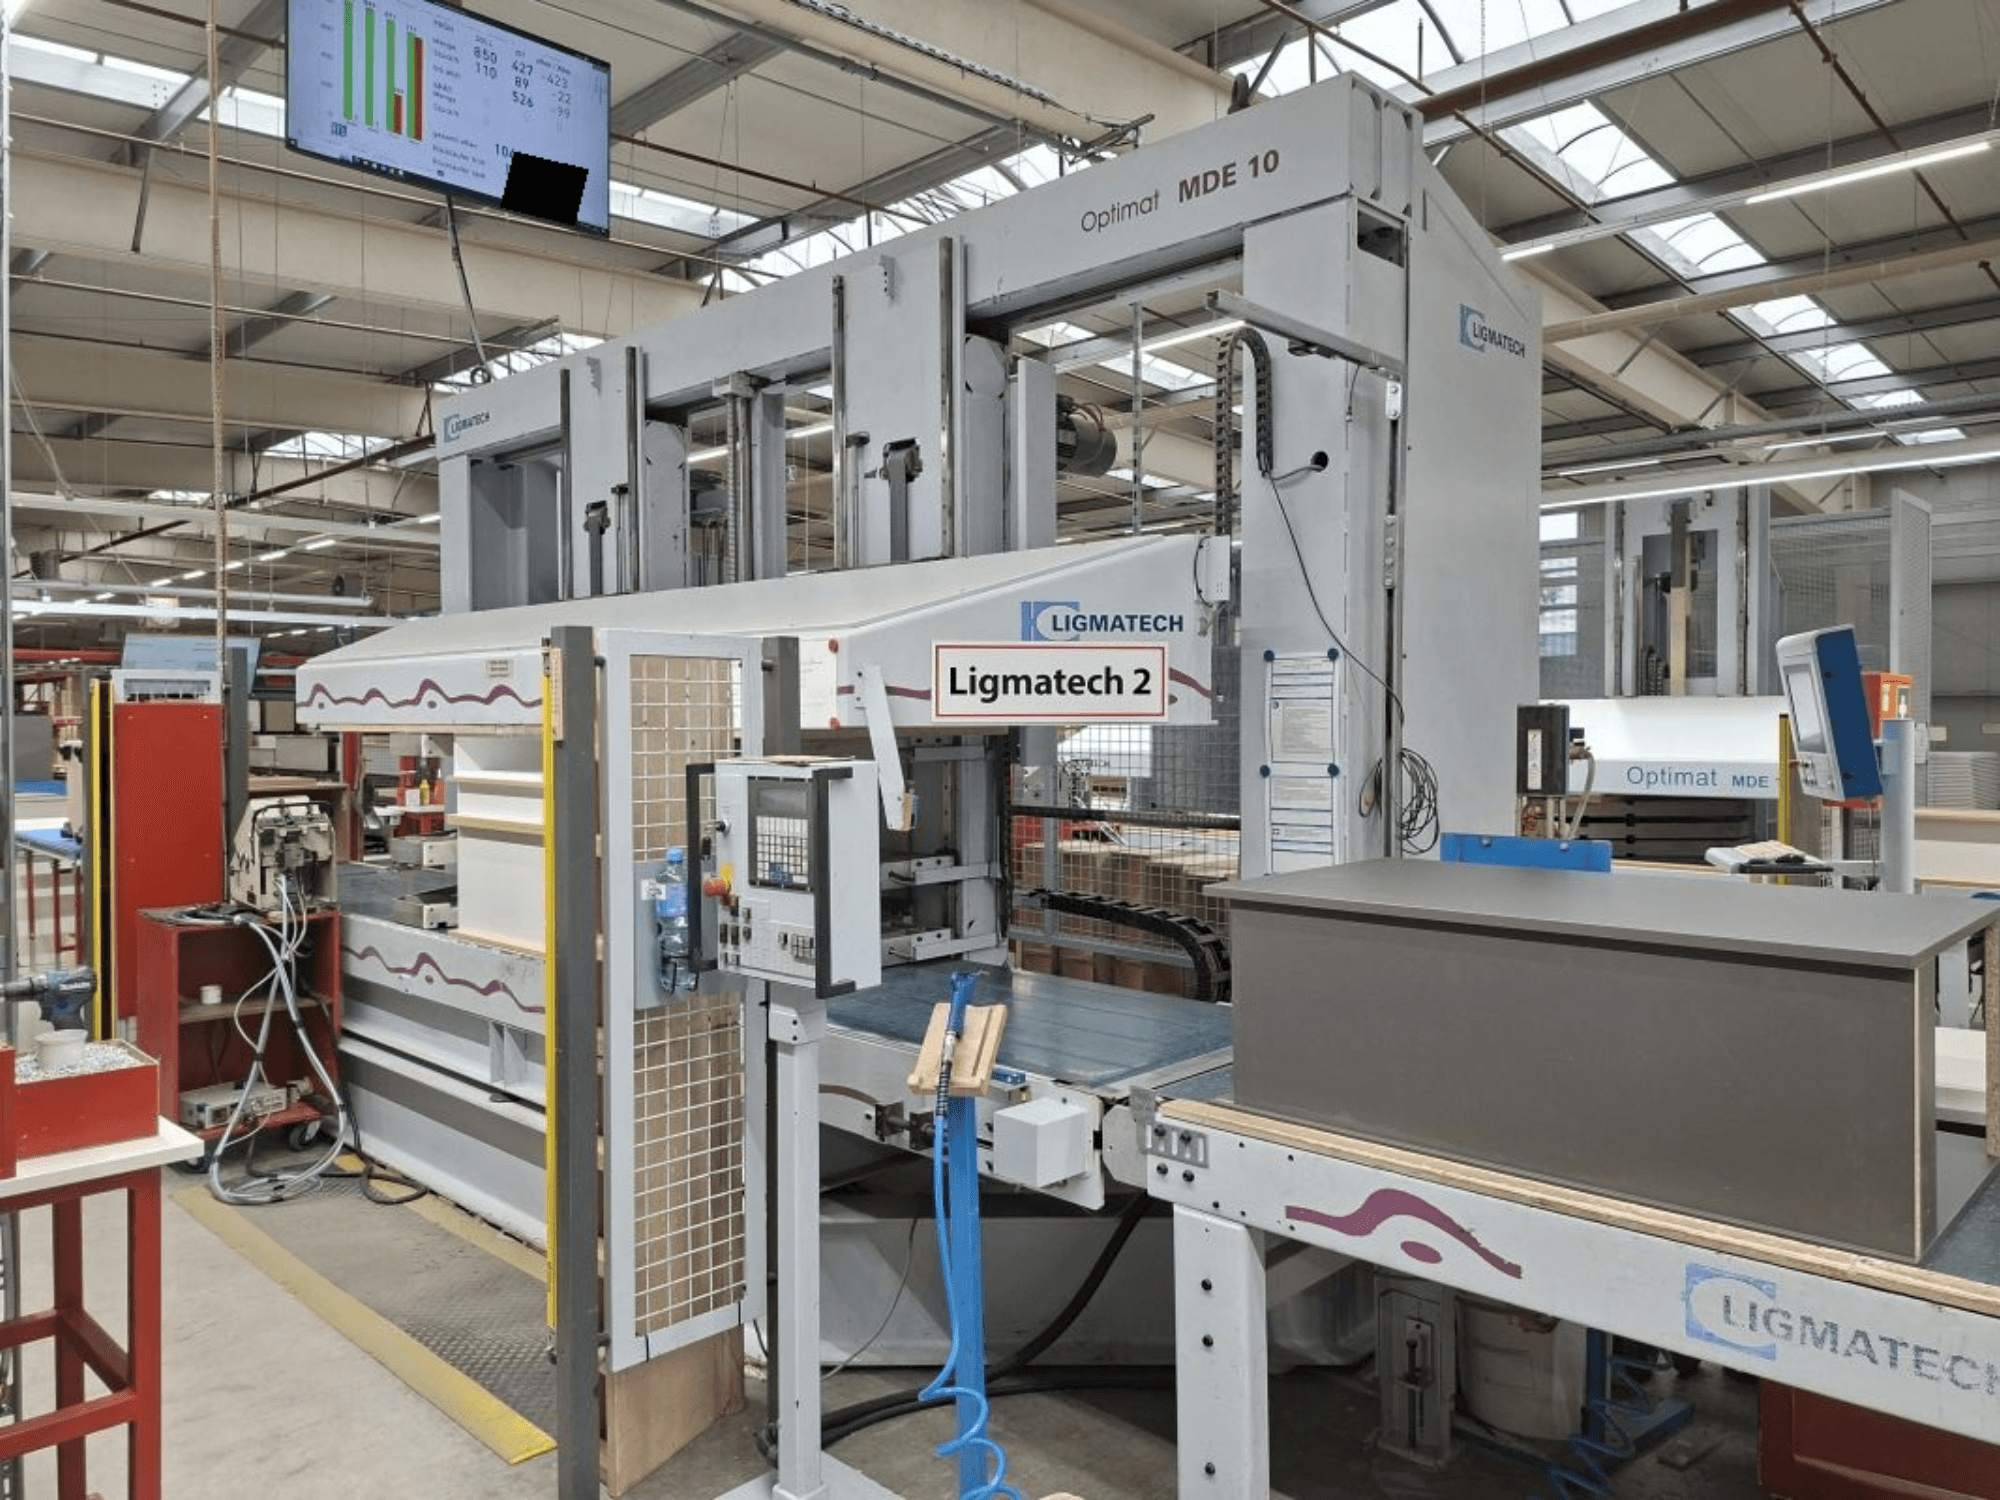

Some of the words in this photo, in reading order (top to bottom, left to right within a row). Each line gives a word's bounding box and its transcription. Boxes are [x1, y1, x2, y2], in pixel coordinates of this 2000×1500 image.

[474, 46, 497, 64] 850
[511, 60, 533, 76] 427
[476, 62, 497, 80] 110
[515, 76, 529, 90] 89
[512, 91, 533, 108] 526
[1081, 189, 1160, 233] Optimat
[1178, 163, 1237, 203] MDE
[1248, 149, 1280, 178] 10
[1473, 322, 1525, 358] LIGMATECH
[1052, 614, 1184, 633] LIGMATECH
[949, 666, 1124, 704] Ligmatech
[1132, 668, 1152, 695] 2
[1626, 765, 1718, 789] Optimat
[1731, 774, 1769, 789] MDE
